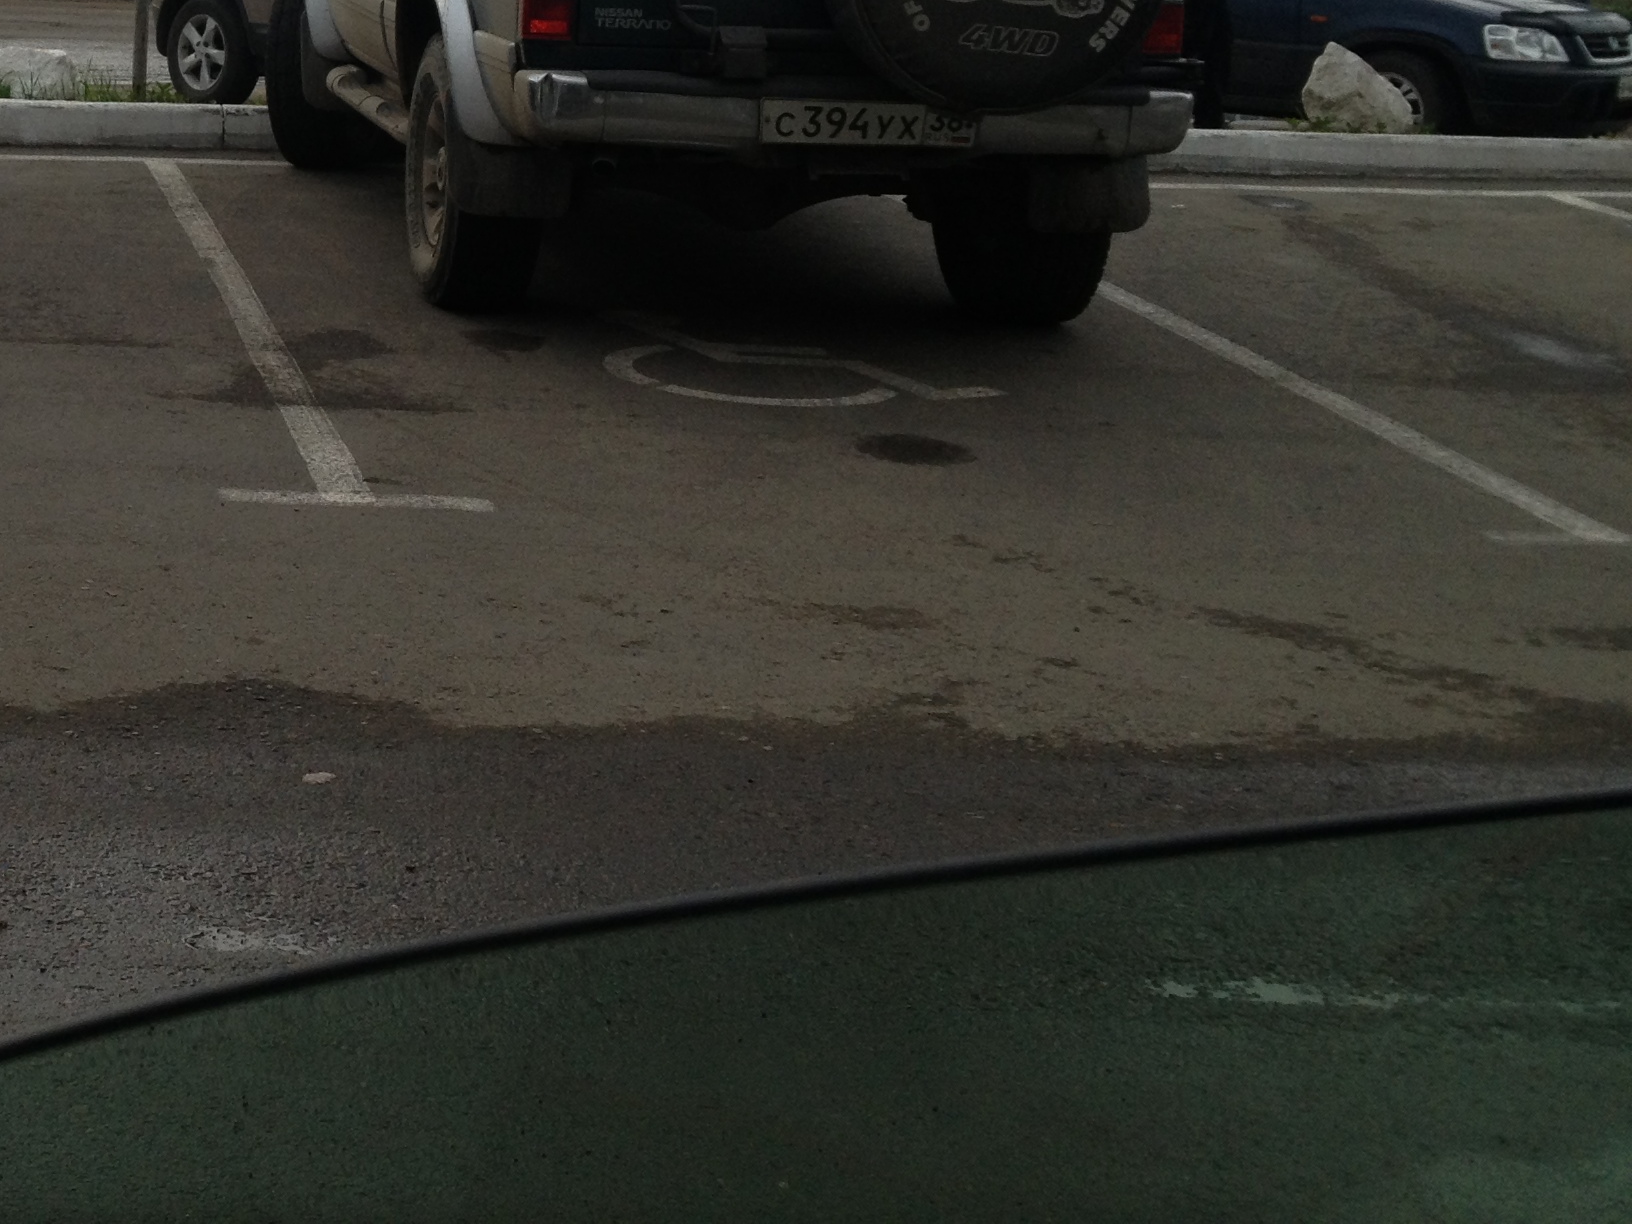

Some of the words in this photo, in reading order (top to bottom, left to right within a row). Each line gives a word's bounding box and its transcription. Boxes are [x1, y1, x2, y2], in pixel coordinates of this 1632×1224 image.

[594, 7, 643, 17] NISSAN
[595, 16, 672, 30] TERRANO
[958, 23, 1060, 57] 4WD
